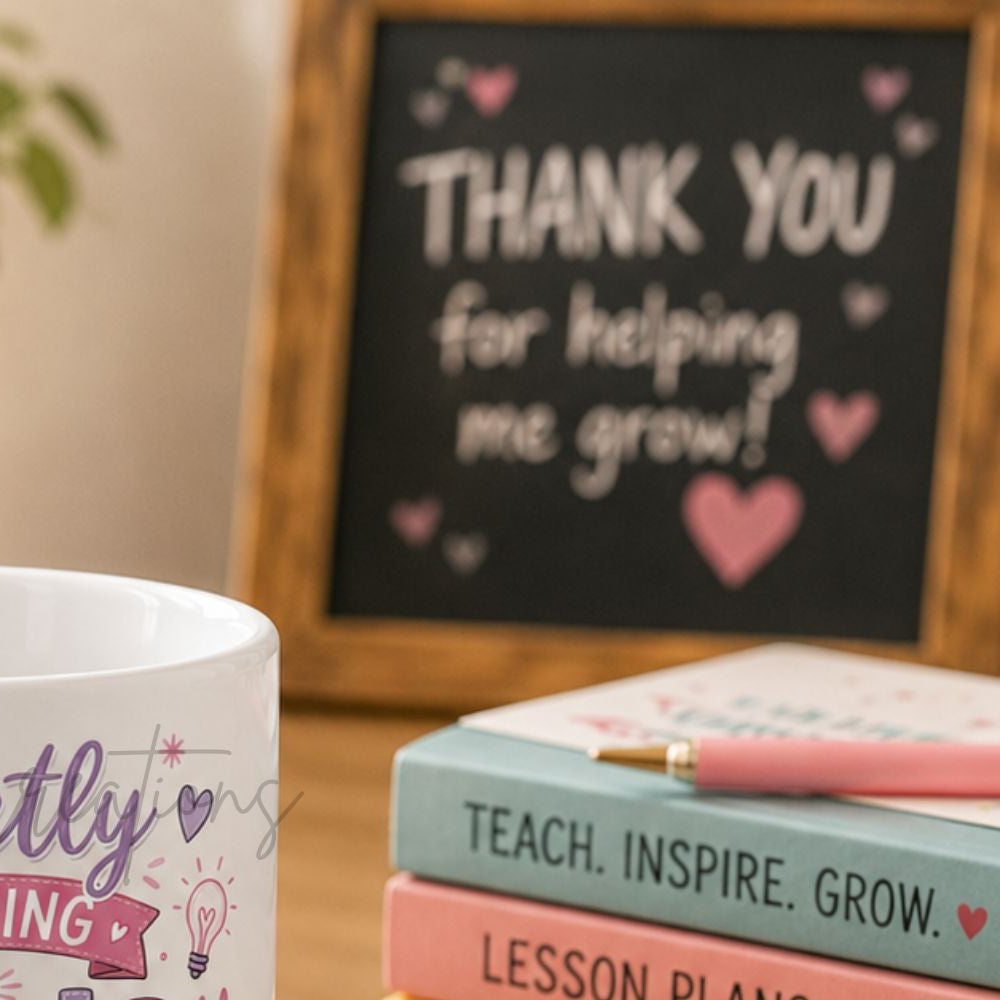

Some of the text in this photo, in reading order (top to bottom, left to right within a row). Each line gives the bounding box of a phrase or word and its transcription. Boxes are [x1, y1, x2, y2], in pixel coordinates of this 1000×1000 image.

[399, 136, 895, 265] THANK YOU
[430, 279, 799, 399] for helping
[455, 371, 773, 500] me grow!
[464, 801, 941, 938] TEACH. INSPIRE. GROW.
